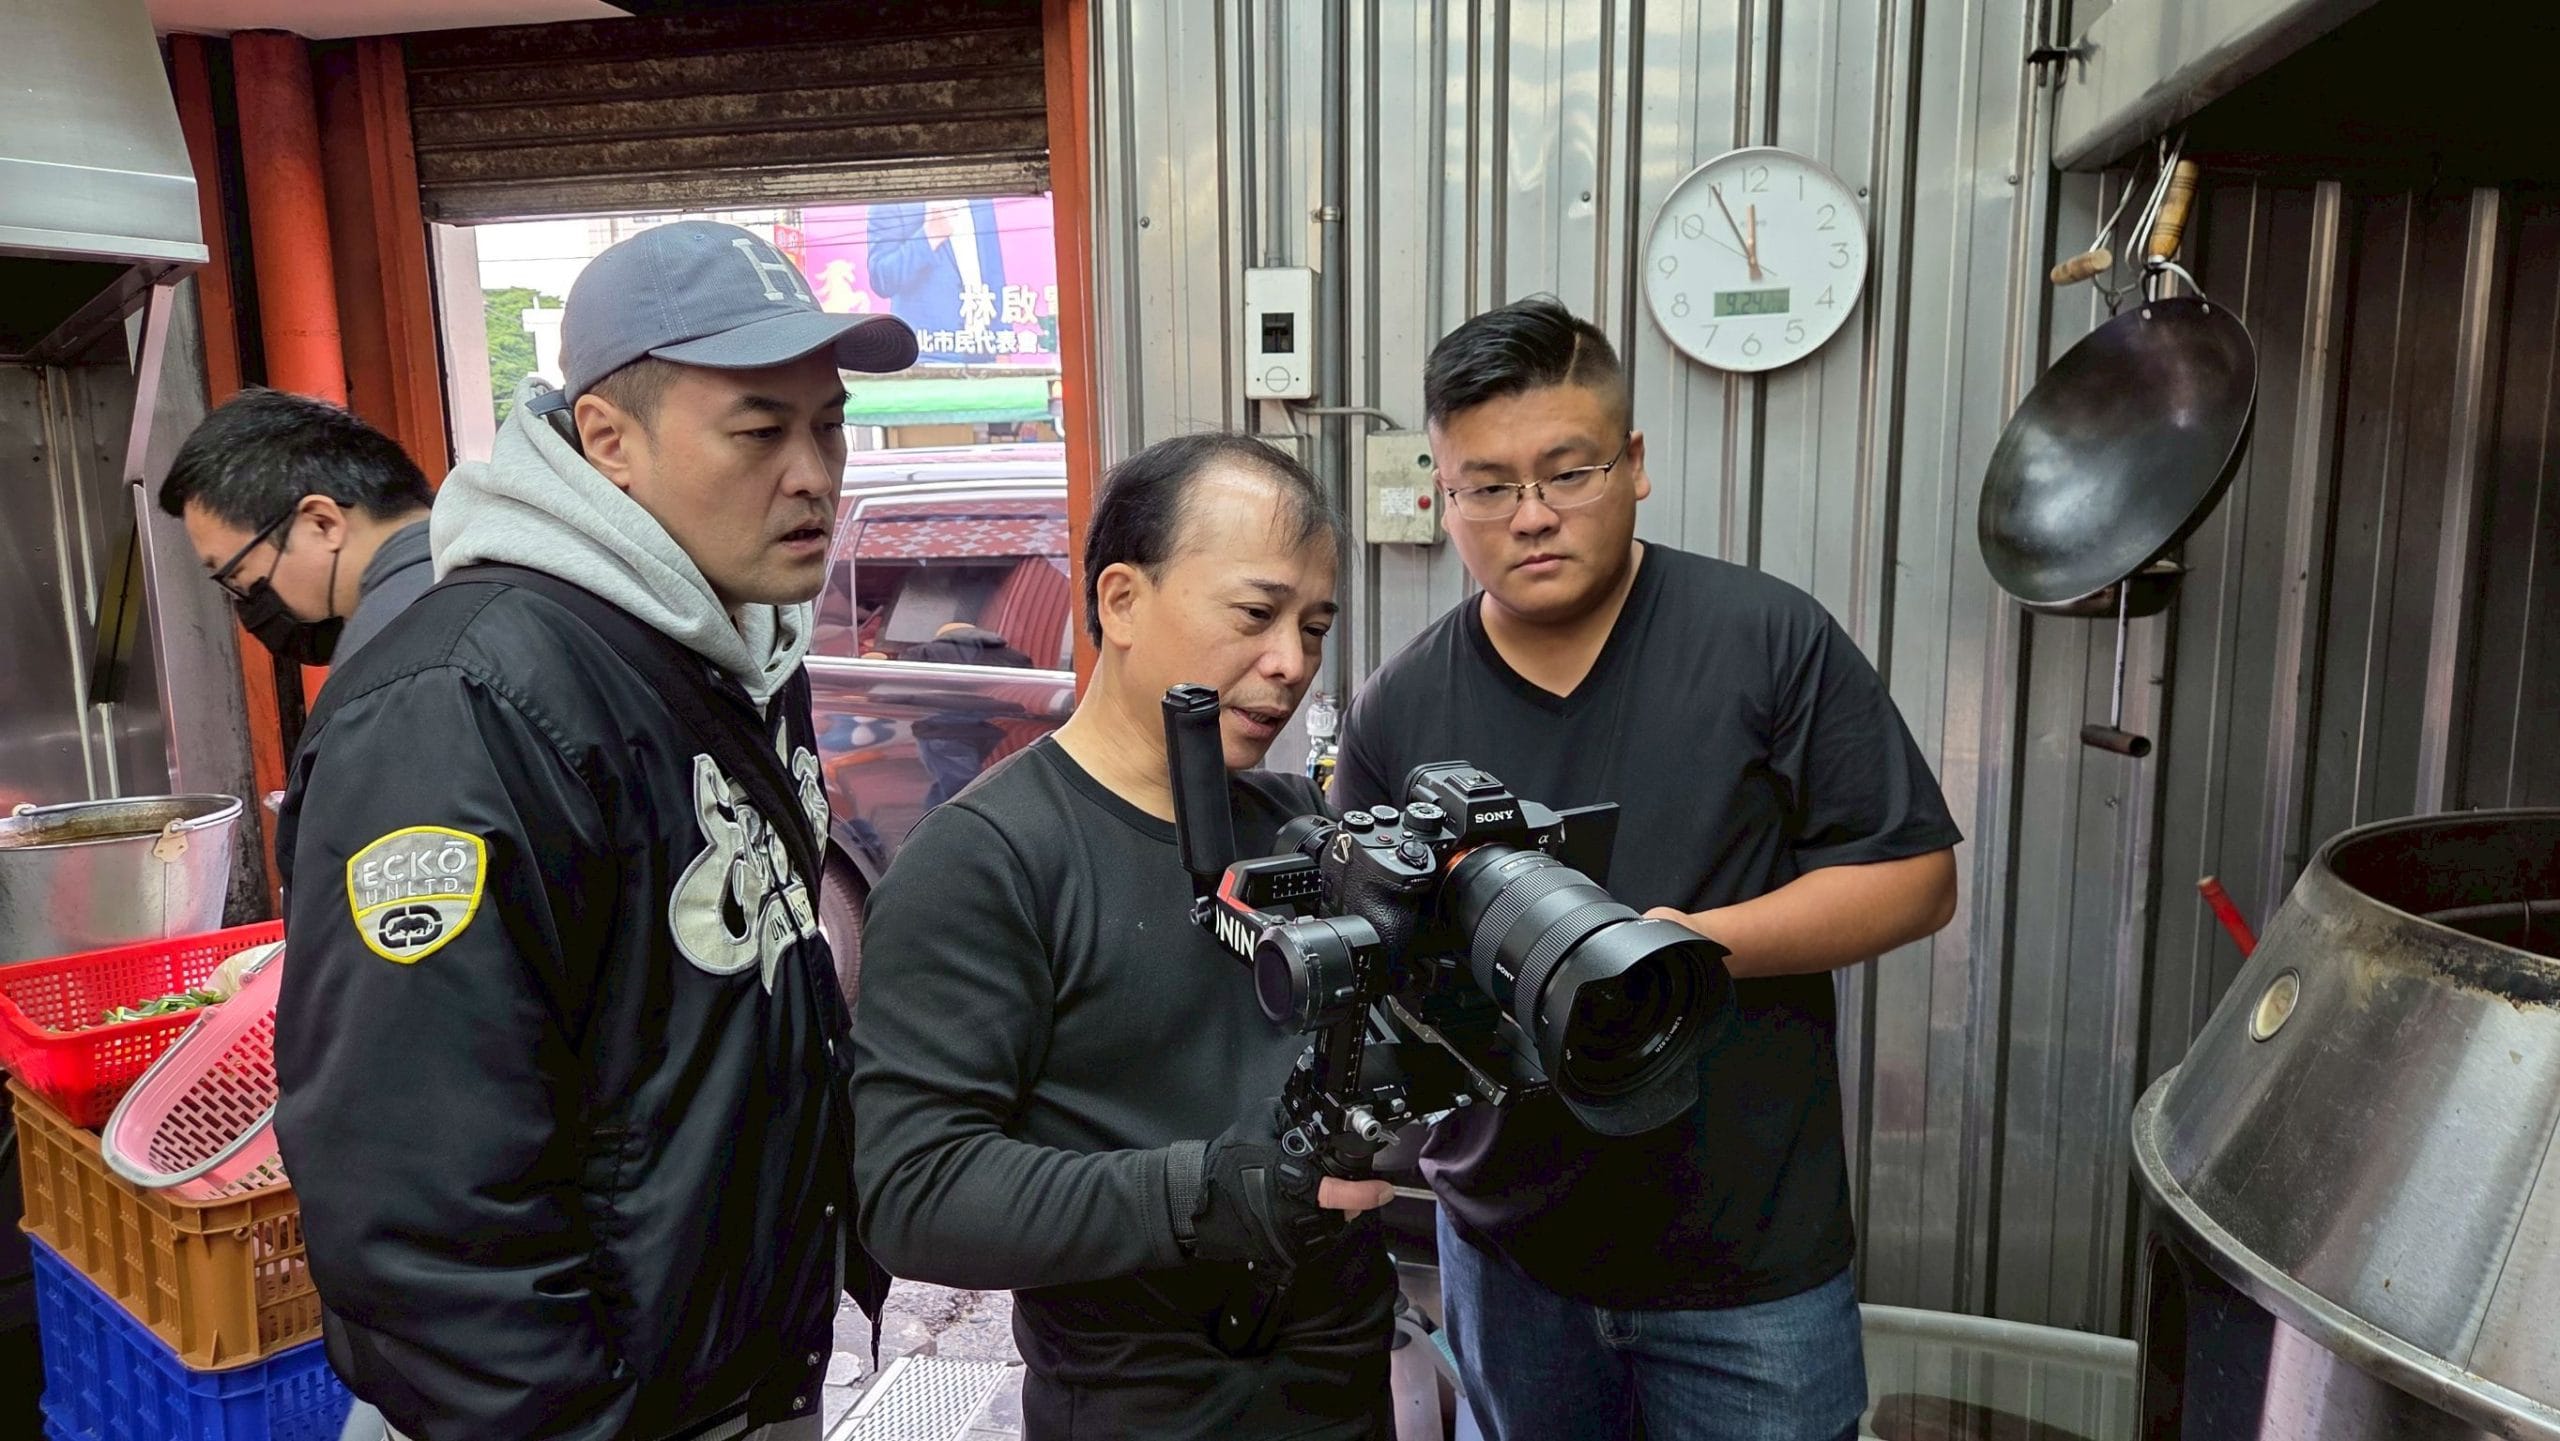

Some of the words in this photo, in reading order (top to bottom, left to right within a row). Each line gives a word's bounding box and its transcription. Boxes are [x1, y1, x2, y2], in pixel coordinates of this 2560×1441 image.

[1741, 165, 1769, 194] 12
[1673, 213, 1705, 240] 10
[1816, 203, 1837, 231] 2
[1657, 255, 1679, 280] 9
[1828, 242, 1850, 270] 3
[732, 237, 812, 304] H
[1670, 292, 1691, 318] 8
[1814, 284, 1836, 310] 4
[916, 329, 1050, 354] 北市民代表會
[1700, 324, 1720, 349] 7
[1741, 332, 1762, 357] 6
[1783, 319, 1806, 345] 5
[1474, 809, 1515, 825] SONY
